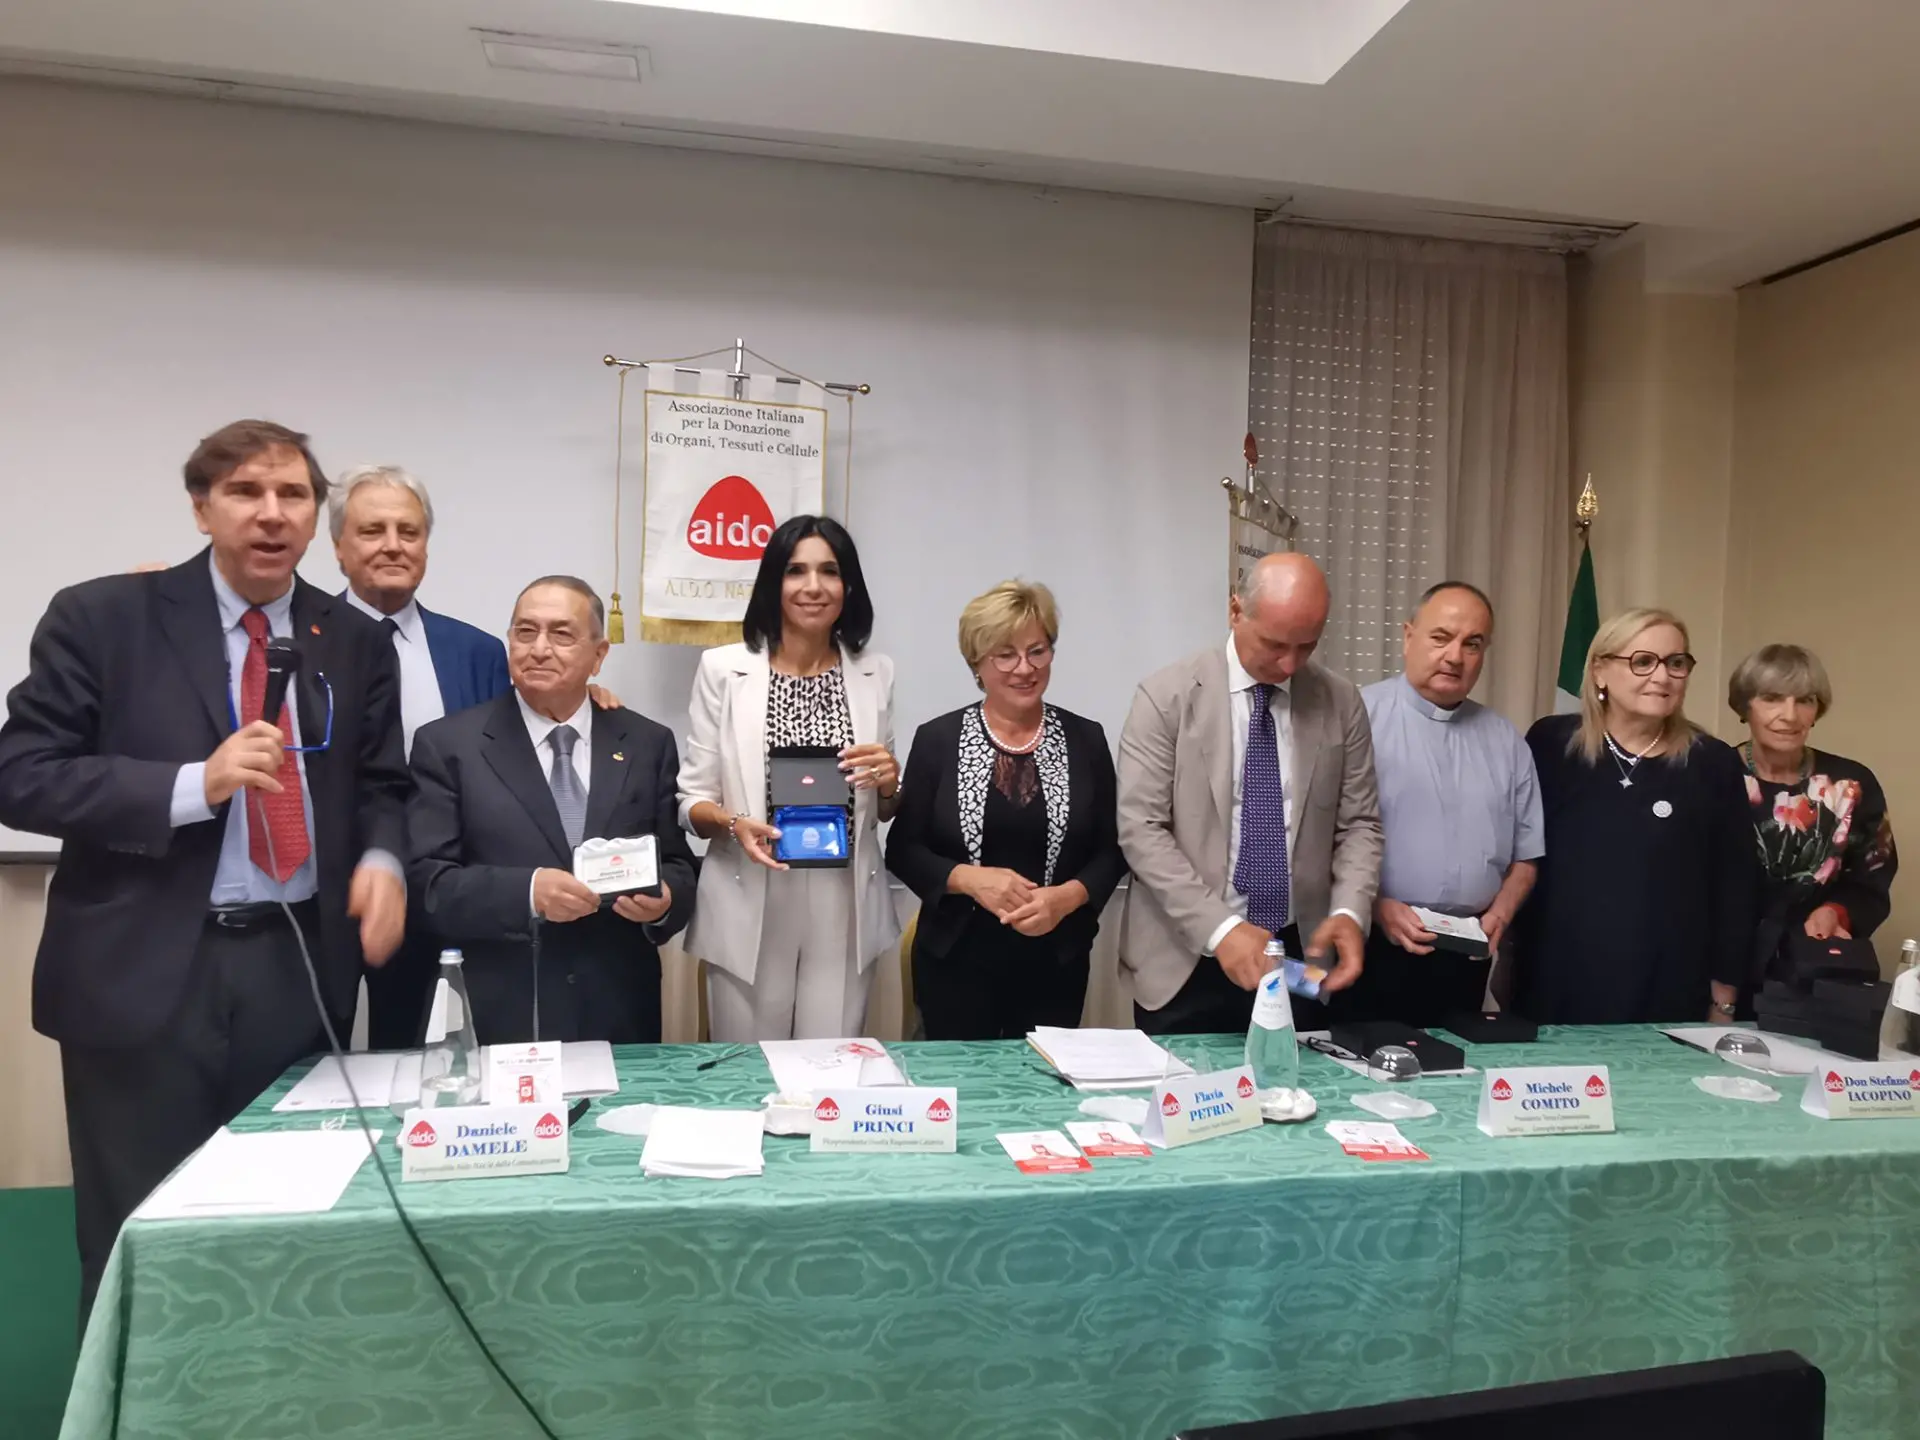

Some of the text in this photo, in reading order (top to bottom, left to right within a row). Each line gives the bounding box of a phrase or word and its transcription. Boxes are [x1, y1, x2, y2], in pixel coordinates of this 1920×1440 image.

[668, 400, 805, 424] Associazione Italiana
[681, 417, 791, 437] per la Donazione
[650, 432, 819, 458] di Organi, Tessuti e Cellule
[689, 512, 775, 547] aido
[1526, 1081, 1573, 1094] Michele
[1844, 1075, 1910, 1087] Don Stefano
[1194, 1088, 1224, 1103] Flavia
[1848, 1090, 1912, 1101] IACOPINO
[865, 1103, 903, 1116] Giusi
[1521, 1097, 1580, 1110] COMITO
[1190, 1102, 1234, 1121] PETRIN
[456, 1121, 518, 1138] Daniele
[535, 1122, 563, 1135] aido
[853, 1120, 915, 1133] PRINCI
[408, 1132, 437, 1144] aido
[445, 1139, 529, 1158] DAMELE
